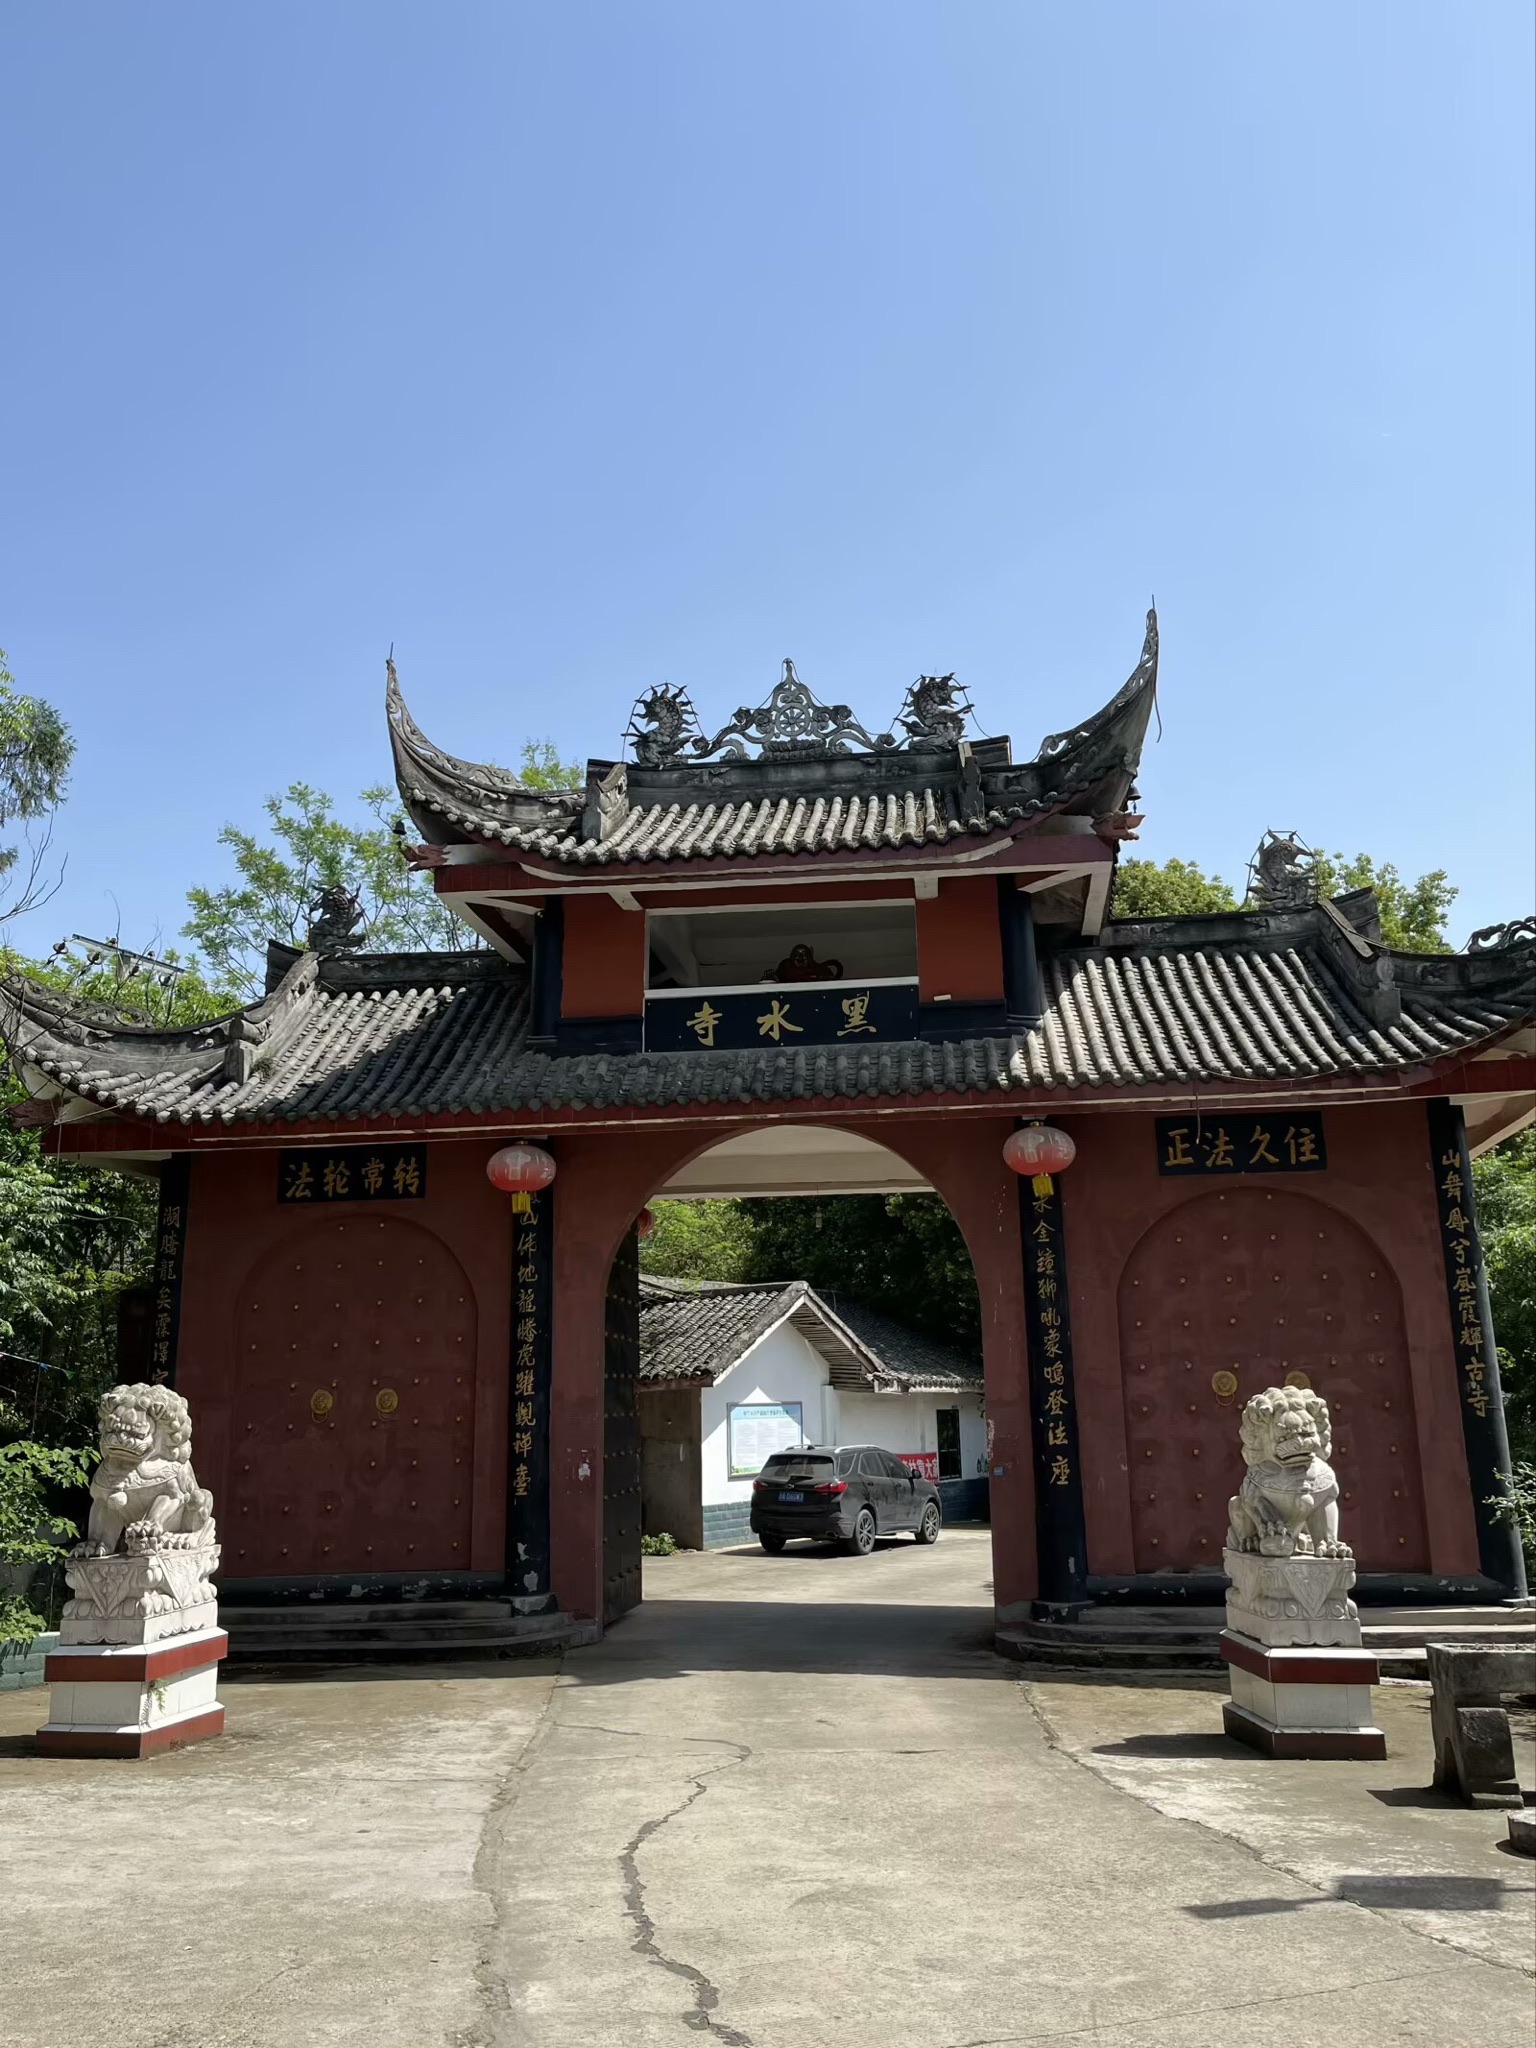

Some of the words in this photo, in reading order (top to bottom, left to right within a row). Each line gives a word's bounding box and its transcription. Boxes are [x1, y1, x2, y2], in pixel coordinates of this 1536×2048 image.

[1165, 1125, 1319, 1167] 正法久住
[285, 1157, 420, 1198] 法轮常转
